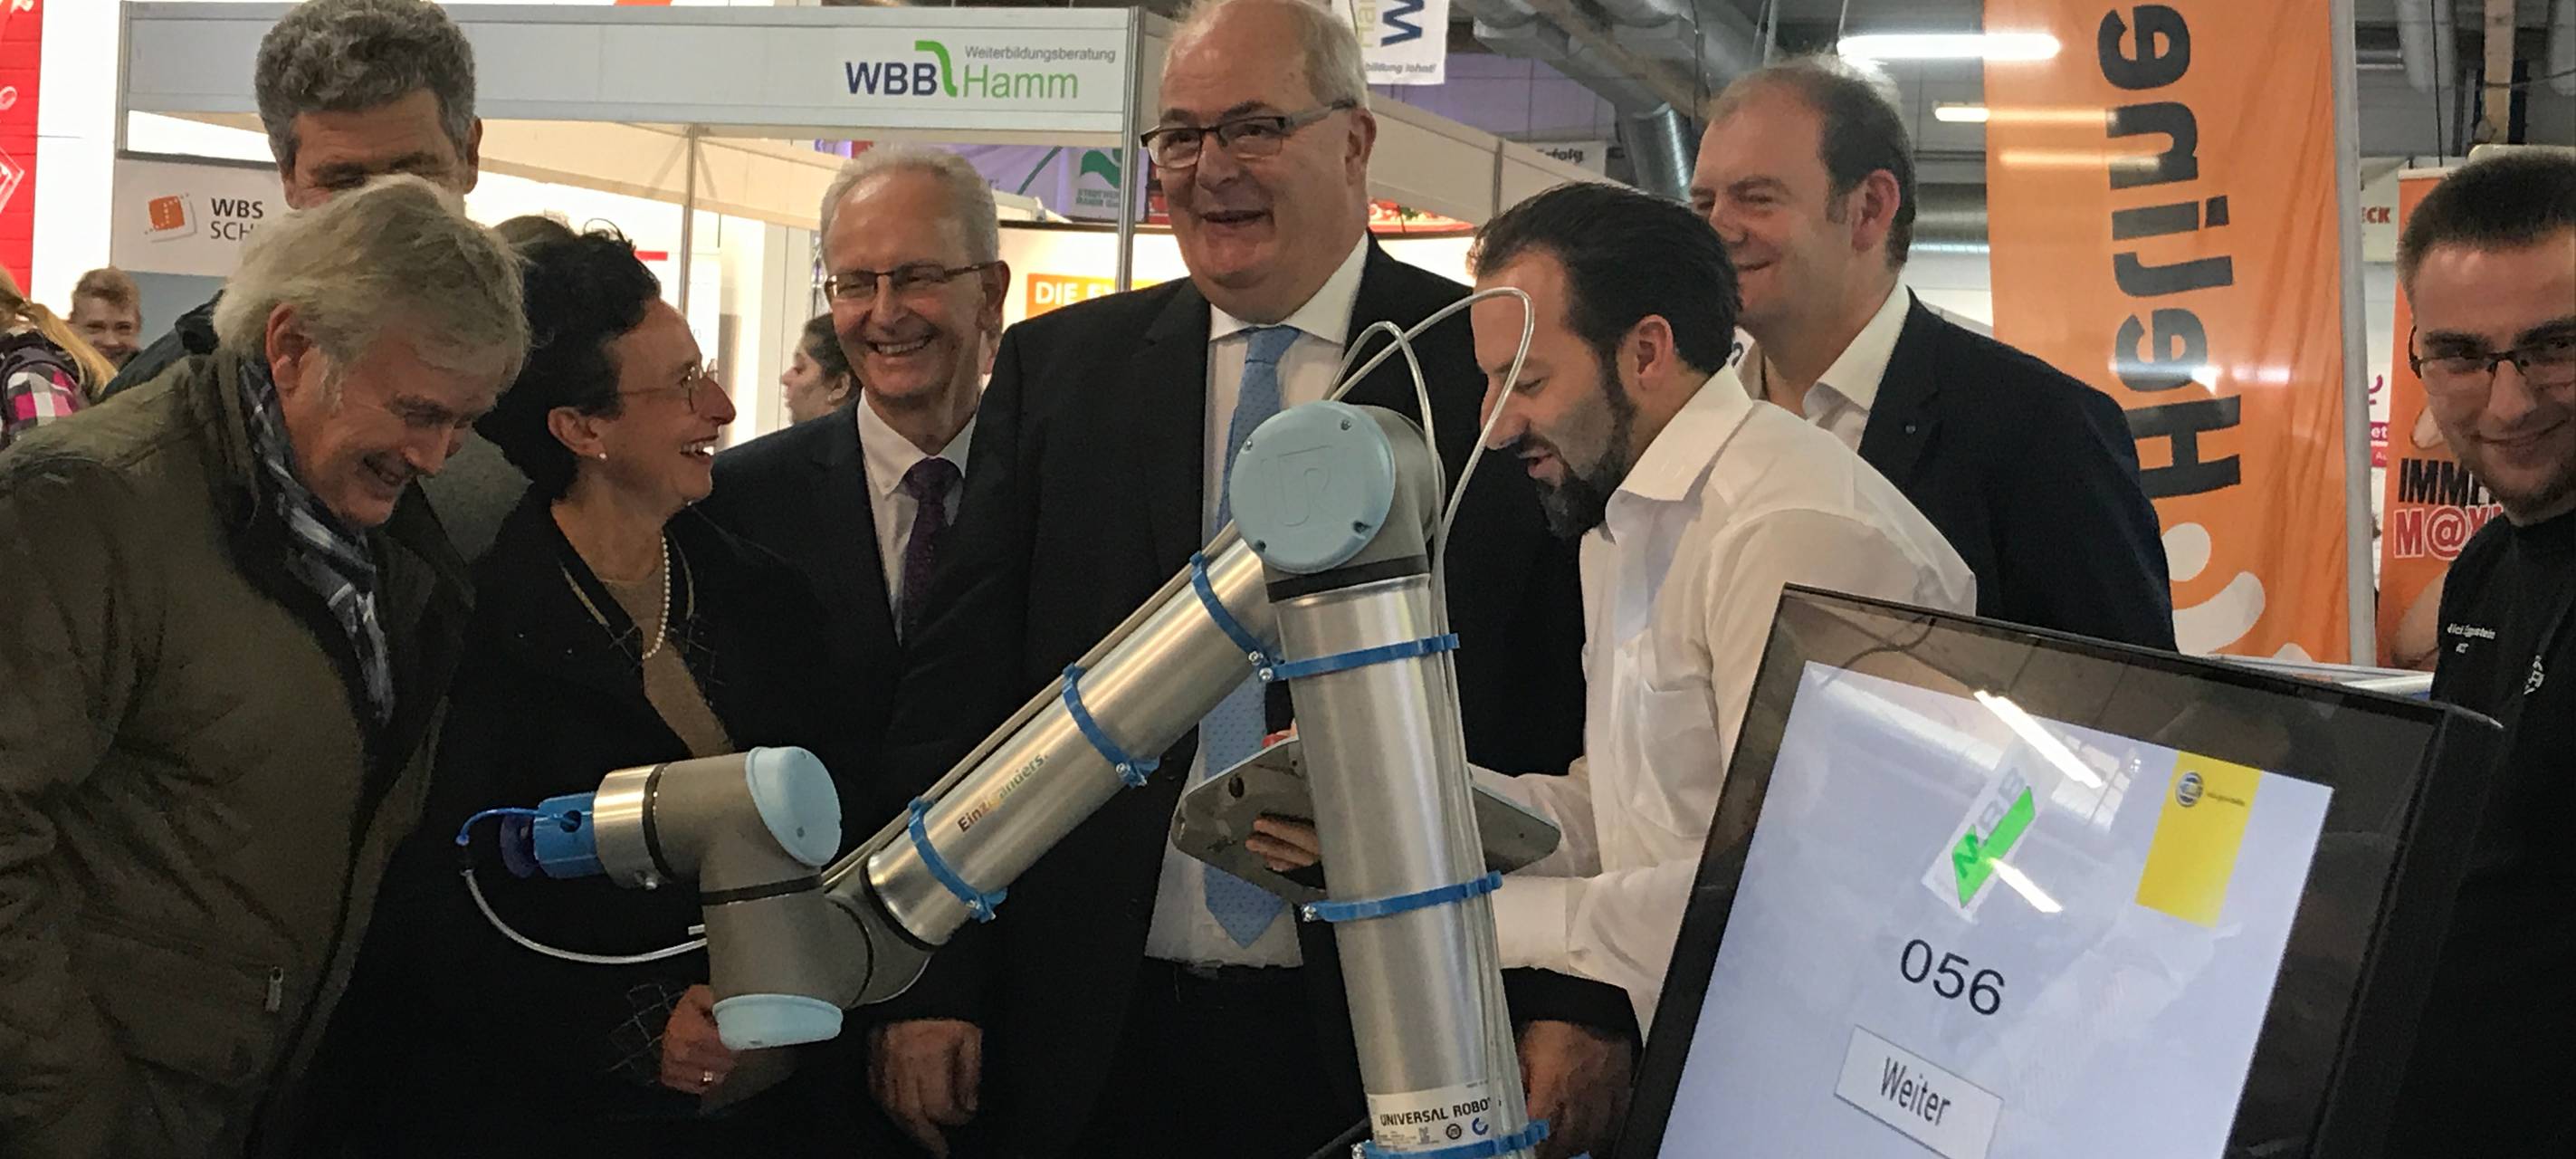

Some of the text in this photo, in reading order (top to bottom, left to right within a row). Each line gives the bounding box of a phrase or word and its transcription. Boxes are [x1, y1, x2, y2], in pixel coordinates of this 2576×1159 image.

[965, 45, 1116, 63] Weiterbildungsberatung
[844, 62, 1079, 99] WBB Hamm
[210, 197, 264, 219] WBS
[1035, 281, 1079, 305] DIE
[1900, 938, 2006, 1016] 056
[1880, 1056, 1951, 1126] Weiter
[1379, 1097, 1502, 1126] UNIVERSAL ROBO
